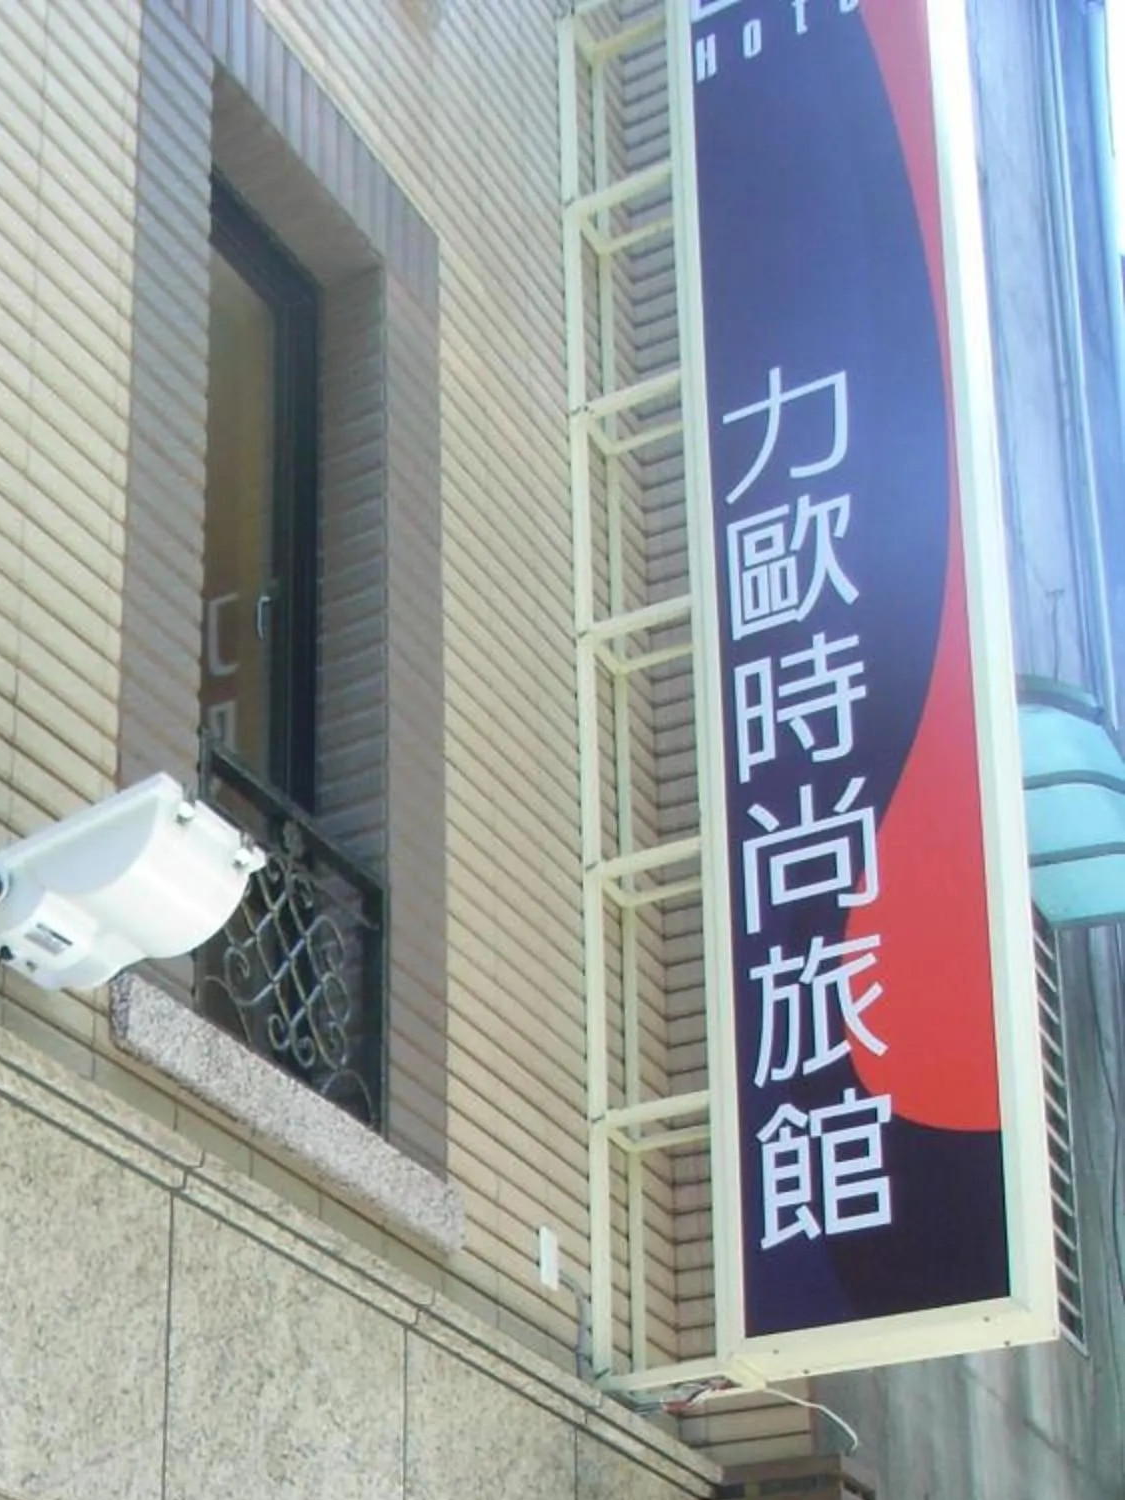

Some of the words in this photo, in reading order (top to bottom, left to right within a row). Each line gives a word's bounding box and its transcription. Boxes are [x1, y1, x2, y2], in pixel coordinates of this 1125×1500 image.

[722, 366, 892, 1251] 力歐時尚旅館
